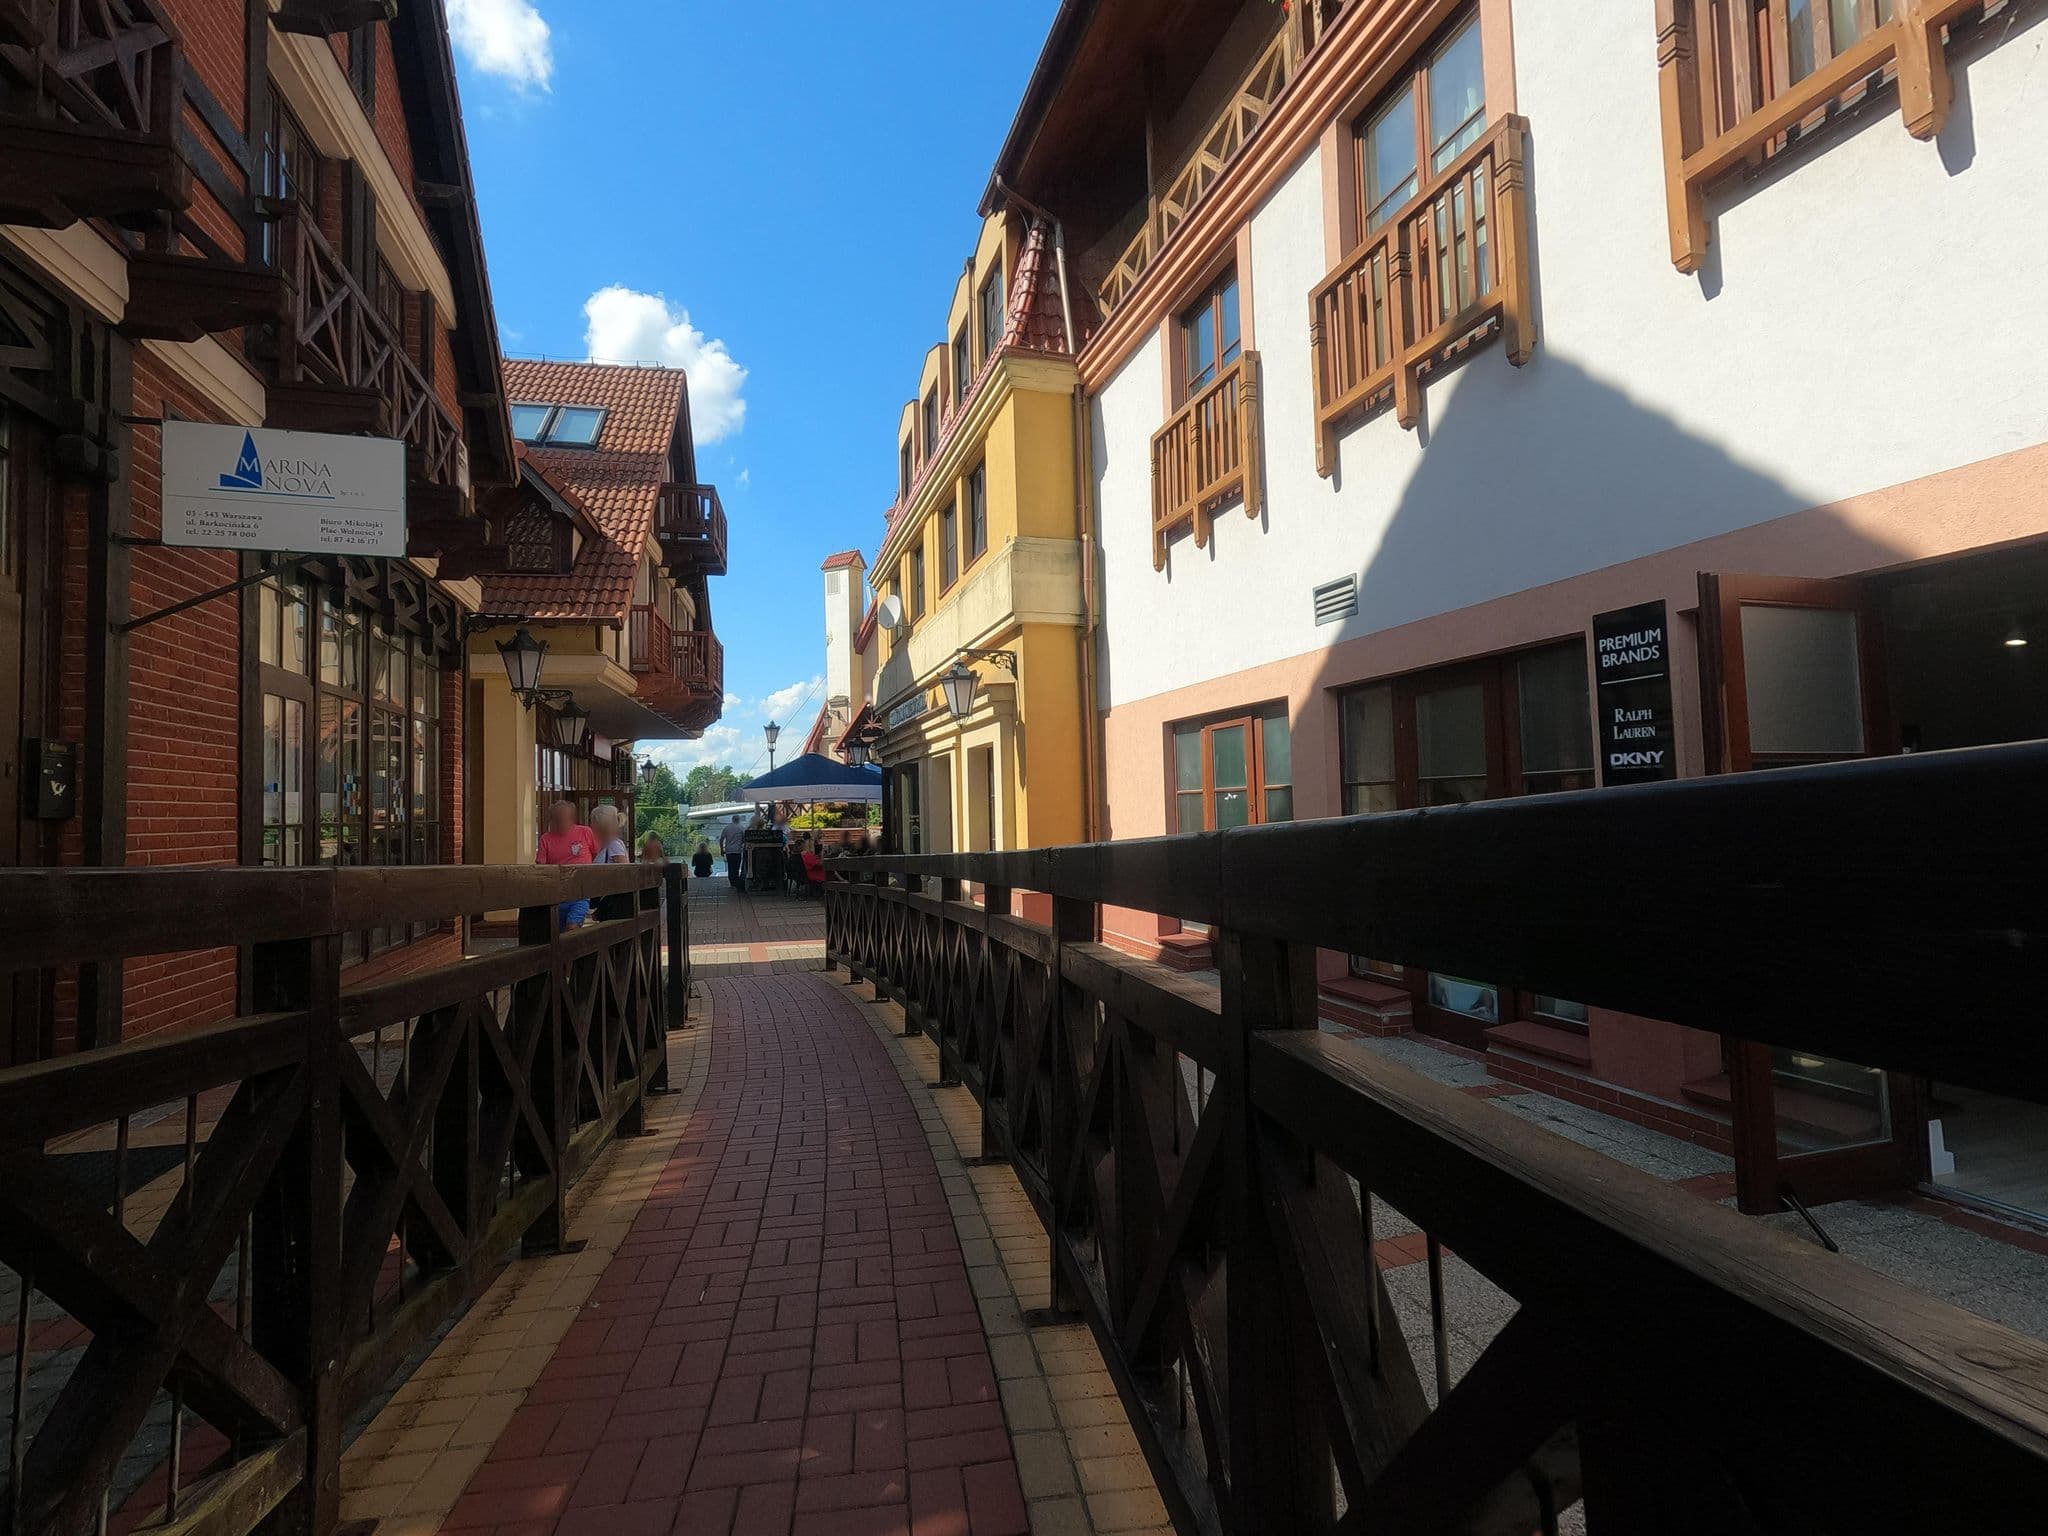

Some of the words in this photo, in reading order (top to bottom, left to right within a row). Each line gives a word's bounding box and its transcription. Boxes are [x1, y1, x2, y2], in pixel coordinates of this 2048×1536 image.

[239, 457, 332, 478] MARINA
[265, 476, 331, 495] NOVA
[222, 512, 263, 521] Warszawa
[320, 518, 342, 526] Biuro
[320, 526, 337, 534] Plac
[1599, 628, 1662, 653] PREMIUM
[1602, 645, 1660, 668] BRANDS
[1614, 708, 1653, 723] RALPH
[1613, 725, 1656, 740] LAUREN
[1610, 750, 1665, 766] DKNY
